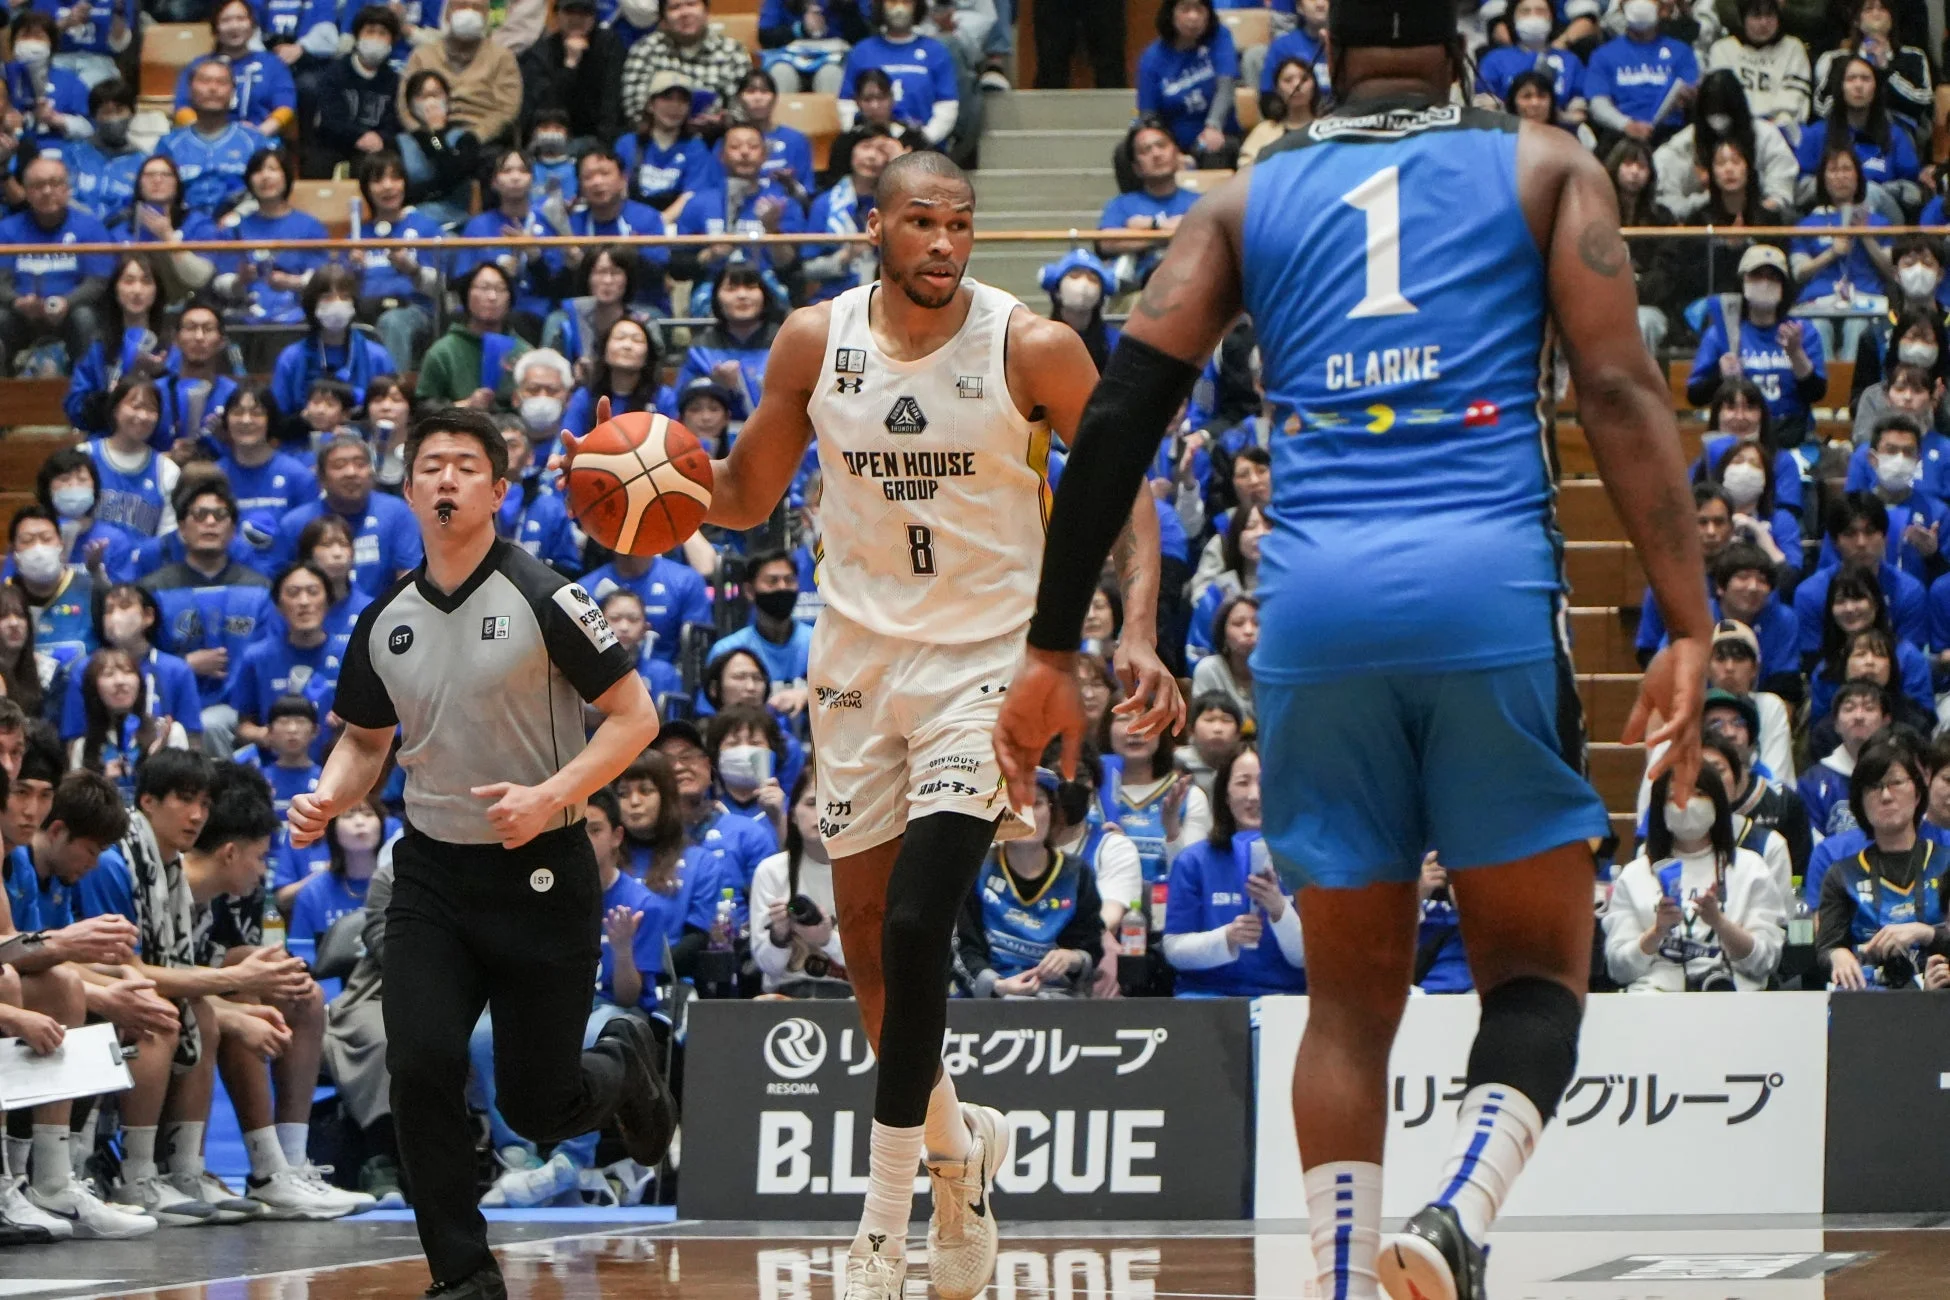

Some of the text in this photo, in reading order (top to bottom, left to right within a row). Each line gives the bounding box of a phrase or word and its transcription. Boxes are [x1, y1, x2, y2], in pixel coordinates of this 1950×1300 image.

[1341, 165, 1418, 320] 1
[1326, 345, 1441, 390] CLARKE
[842, 451, 976, 478] OPEN HOUSE
[882, 480, 938, 501] GROUP
[904, 522, 938, 577] 8
[946, 755, 982, 767] HOUSE
[840, 1027, 1169, 1077] りなグループ
[766, 1083, 820, 1096] RESONA
[756, 1109, 1166, 1195] B.LGUE
